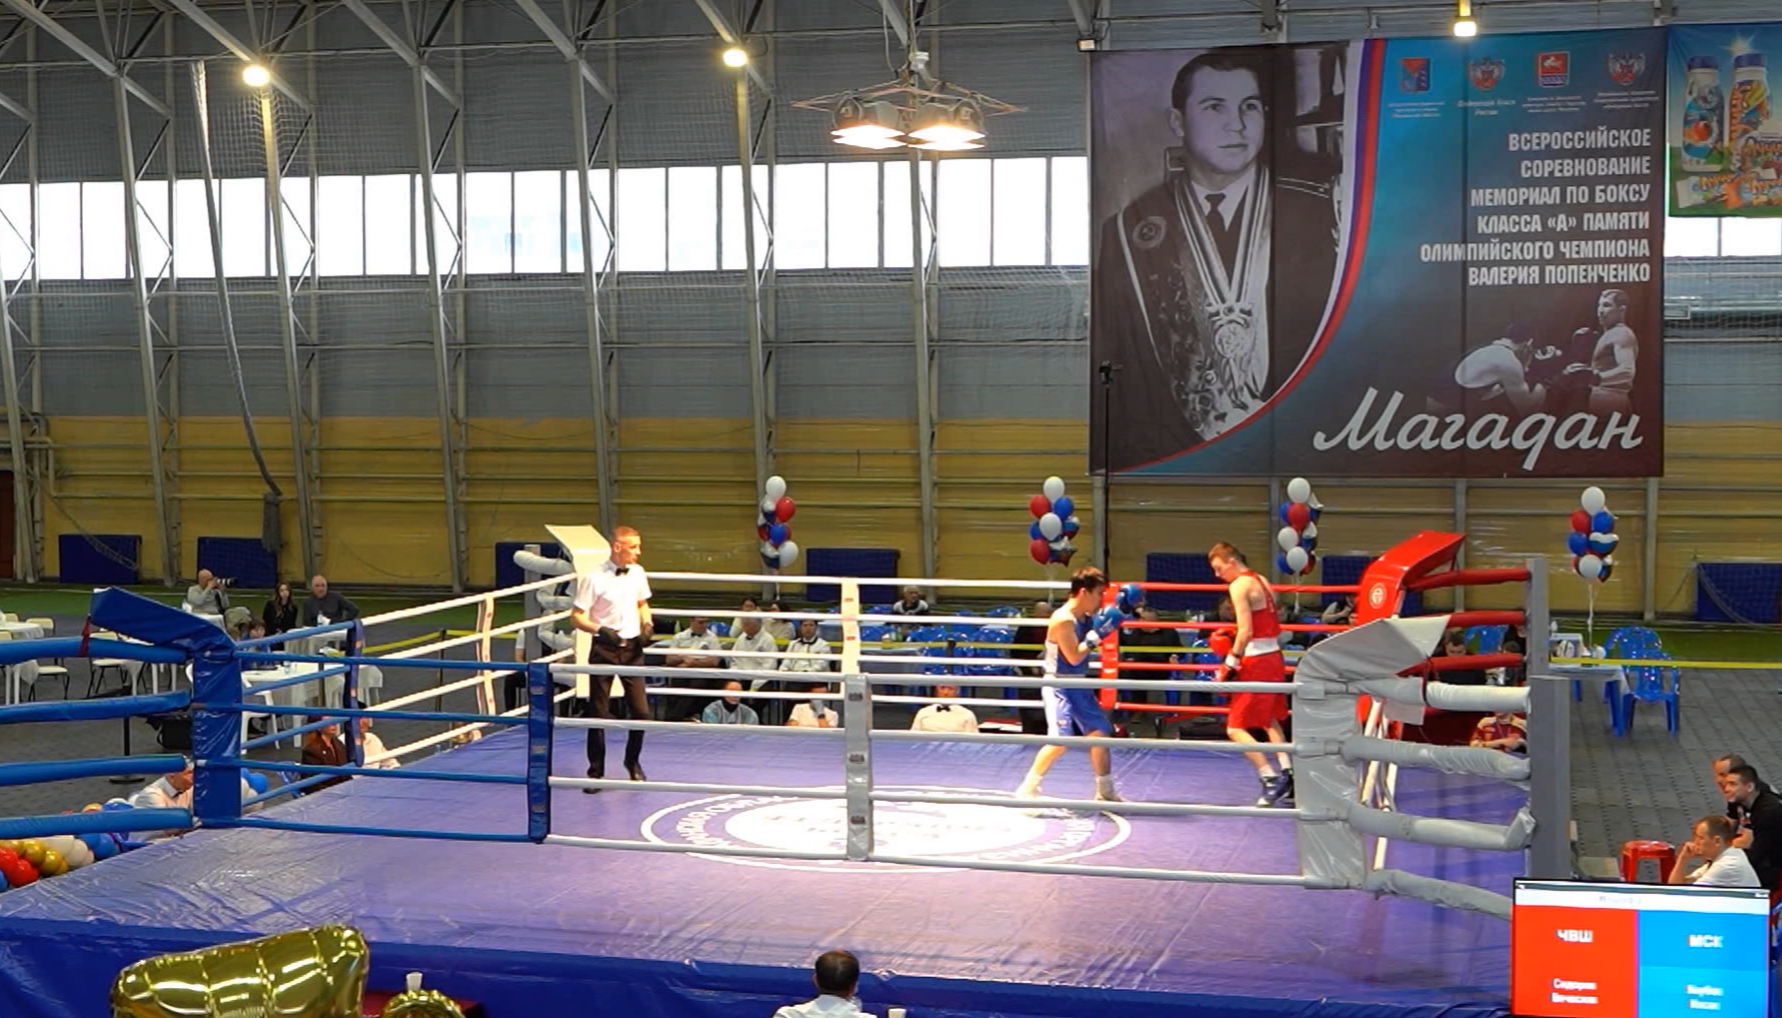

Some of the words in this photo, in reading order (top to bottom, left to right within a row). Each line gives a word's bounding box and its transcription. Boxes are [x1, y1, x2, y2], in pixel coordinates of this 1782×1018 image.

[1508, 125, 1651, 152] ВСЕРОССИЙСКОЕ
[1520, 156, 1651, 178] СОРЕВНОВАНИЕ
[1470, 186, 1561, 207] МЕМОРИАЛ
[1566, 185, 1589, 204] ПО
[1594, 183, 1651, 204] БОКСУ
[1477, 214, 1543, 234] КЛАССА
[1583, 211, 1650, 231] ПАМЯТИ
[1420, 238, 1554, 262] ОЛИМПИЙСКОГО
[1559, 238, 1650, 259] ЧЕМПИОНА
[1468, 265, 1540, 286] ВАЛЕРИЯ
[1544, 262, 1650, 284] ПОПЕНЧЕНКО
[1312, 386, 1643, 471] Магадан
[1557, 929, 1593, 943] ЧВШ
[1687, 934, 1724, 948] МСК
